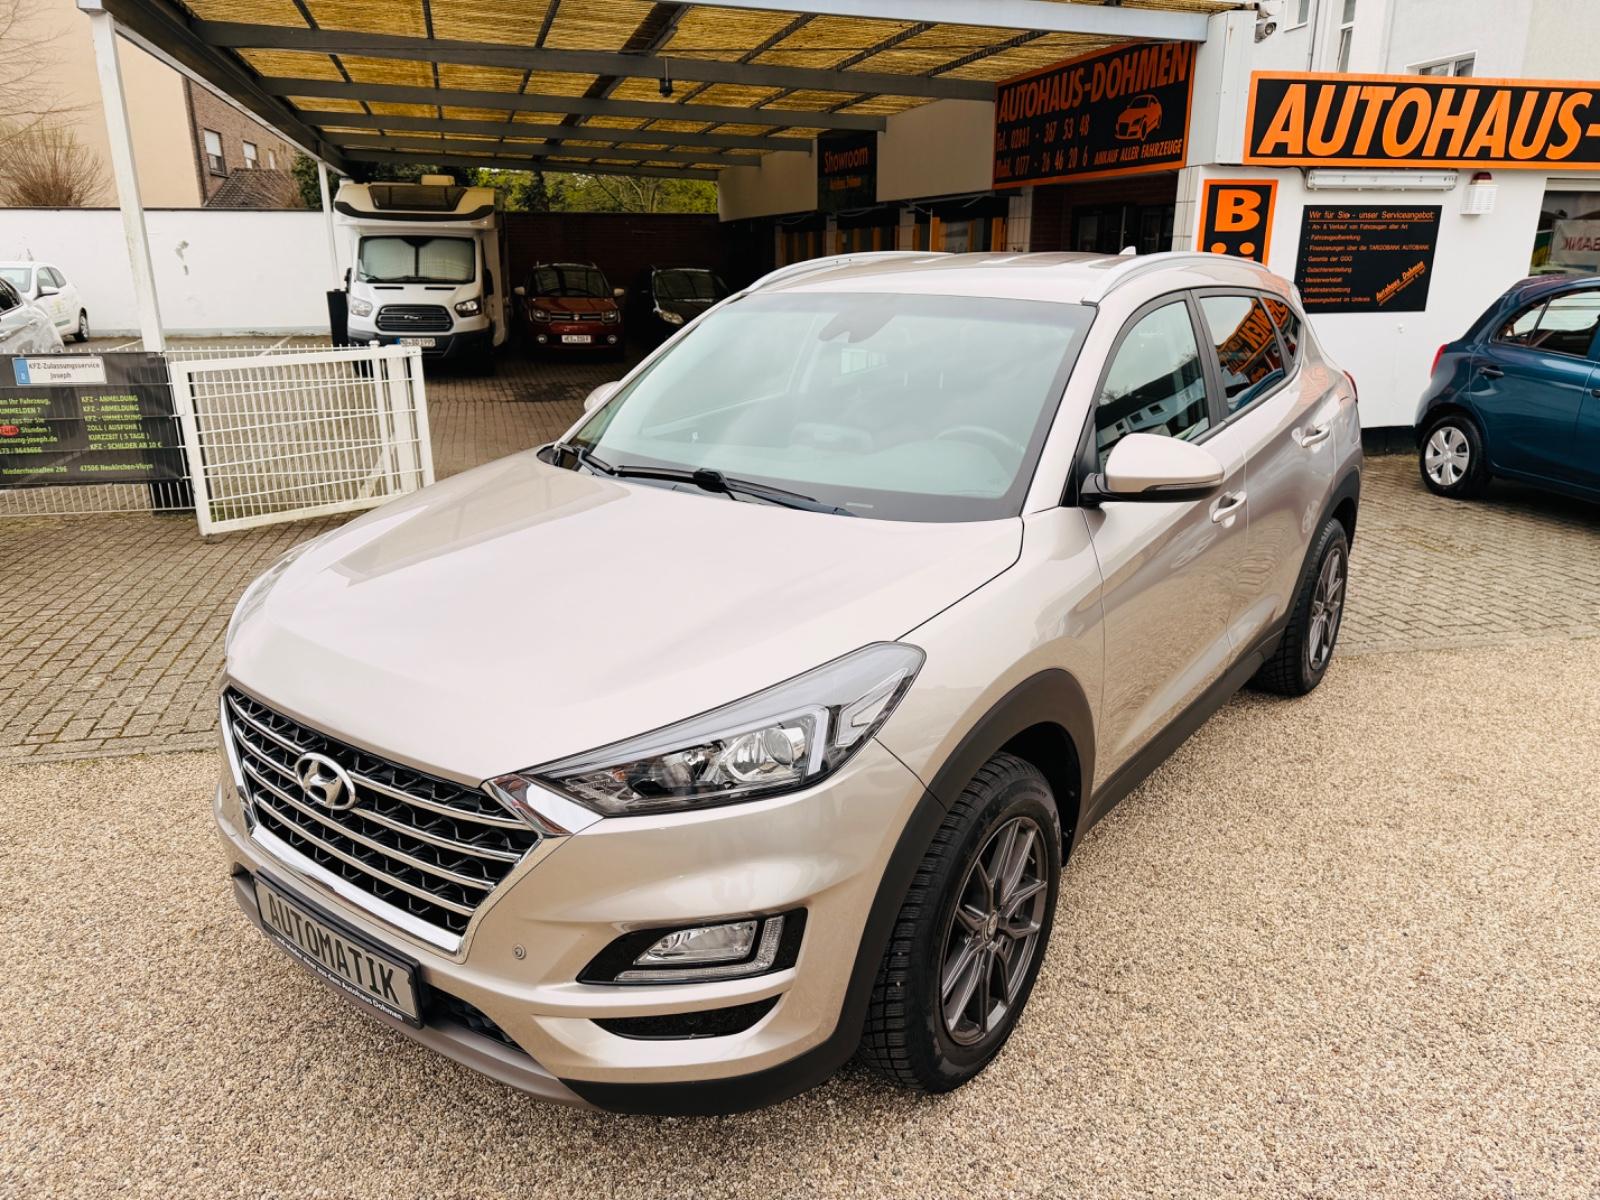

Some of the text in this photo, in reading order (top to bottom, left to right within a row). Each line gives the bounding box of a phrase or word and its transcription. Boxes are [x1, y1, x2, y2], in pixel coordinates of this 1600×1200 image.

[998, 41, 1191, 124] AUTOHAUS-DOHMEN
[1120, 145, 1139, 161] ALLER
[1141, 138, 1183, 158] FAHRZEUGE
[1256, 83, 1600, 161] AUTOHAUS-
[1309, 211, 1321, 219] Wir
[1325, 211, 1334, 219] für
[268, 893, 400, 1005] AUTOMATIK
